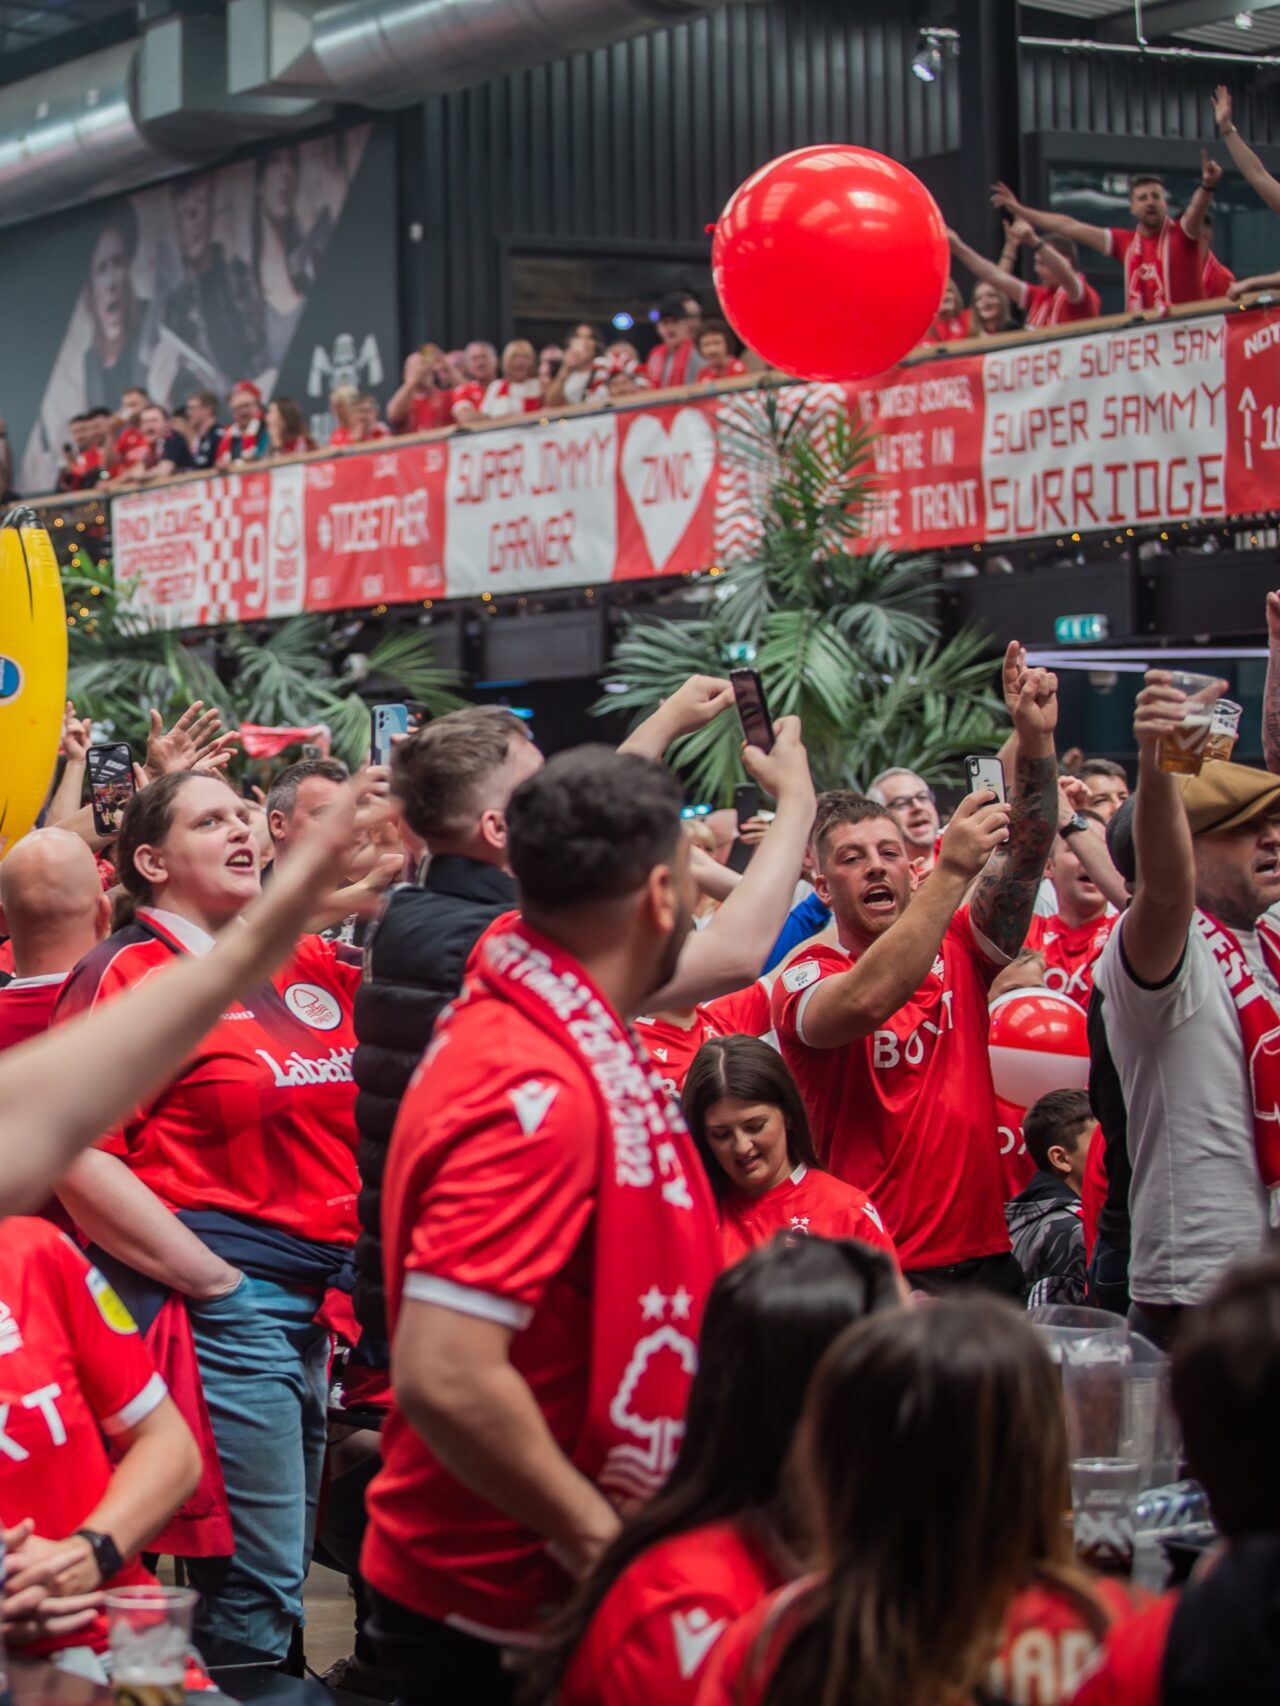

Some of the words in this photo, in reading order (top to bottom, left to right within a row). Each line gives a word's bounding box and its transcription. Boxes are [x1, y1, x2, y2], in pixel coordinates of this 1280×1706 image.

[1079, 333, 1160, 379] SUPER
[1172, 327, 1225, 366] SAM
[989, 400, 1090, 454] SUPER
[1100, 382, 1226, 440] SAMMY
[456, 442, 526, 503] SUPER
[531, 429, 614, 495] JIMMY
[640, 451, 692, 505] ZINC
[988, 454, 1224, 535] SURRIDGE
[910, 479, 978, 533] TRENT
[244, 521, 267, 608] 9
[488, 511, 576, 573] GARNER
